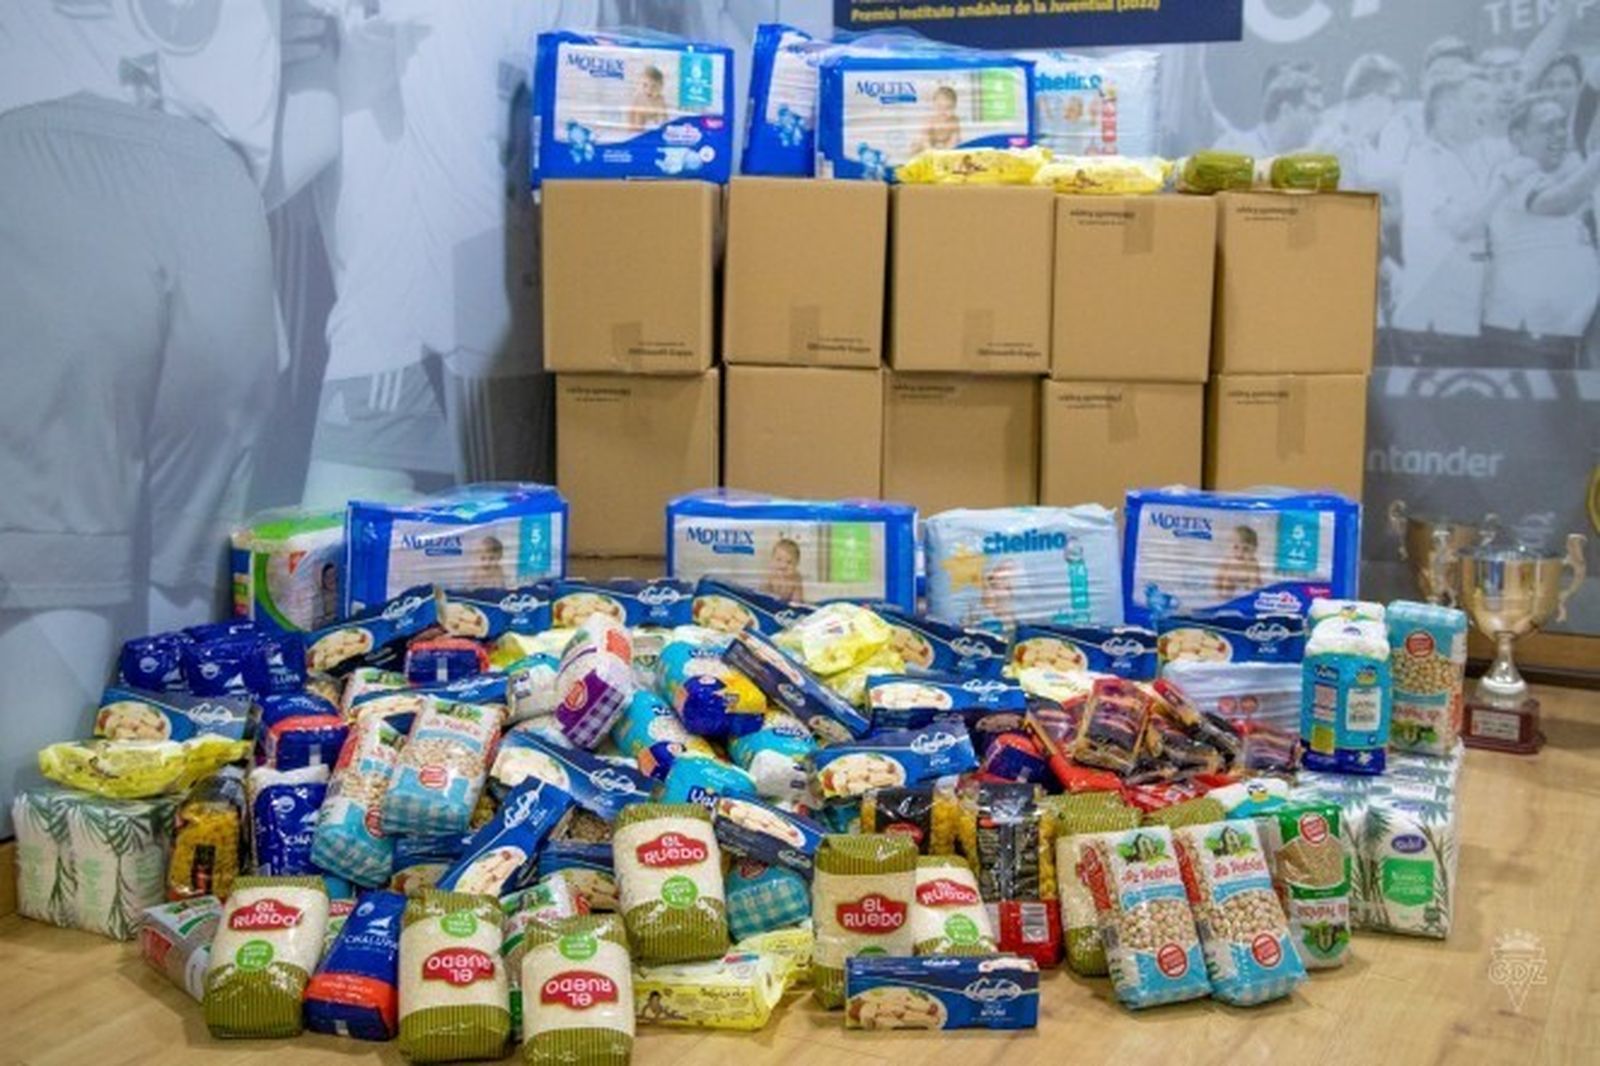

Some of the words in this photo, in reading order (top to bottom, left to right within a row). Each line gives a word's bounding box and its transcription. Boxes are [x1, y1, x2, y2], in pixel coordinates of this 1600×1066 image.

[1014, 1, 1031, 15] de
[1034, 1, 1047, 13] la
[1149, 511, 1213, 531] MOLTEX
[530, 527, 543, 543] 5
[686, 526, 755, 546] MOLTEX
[982, 529, 1067, 555] chelino
